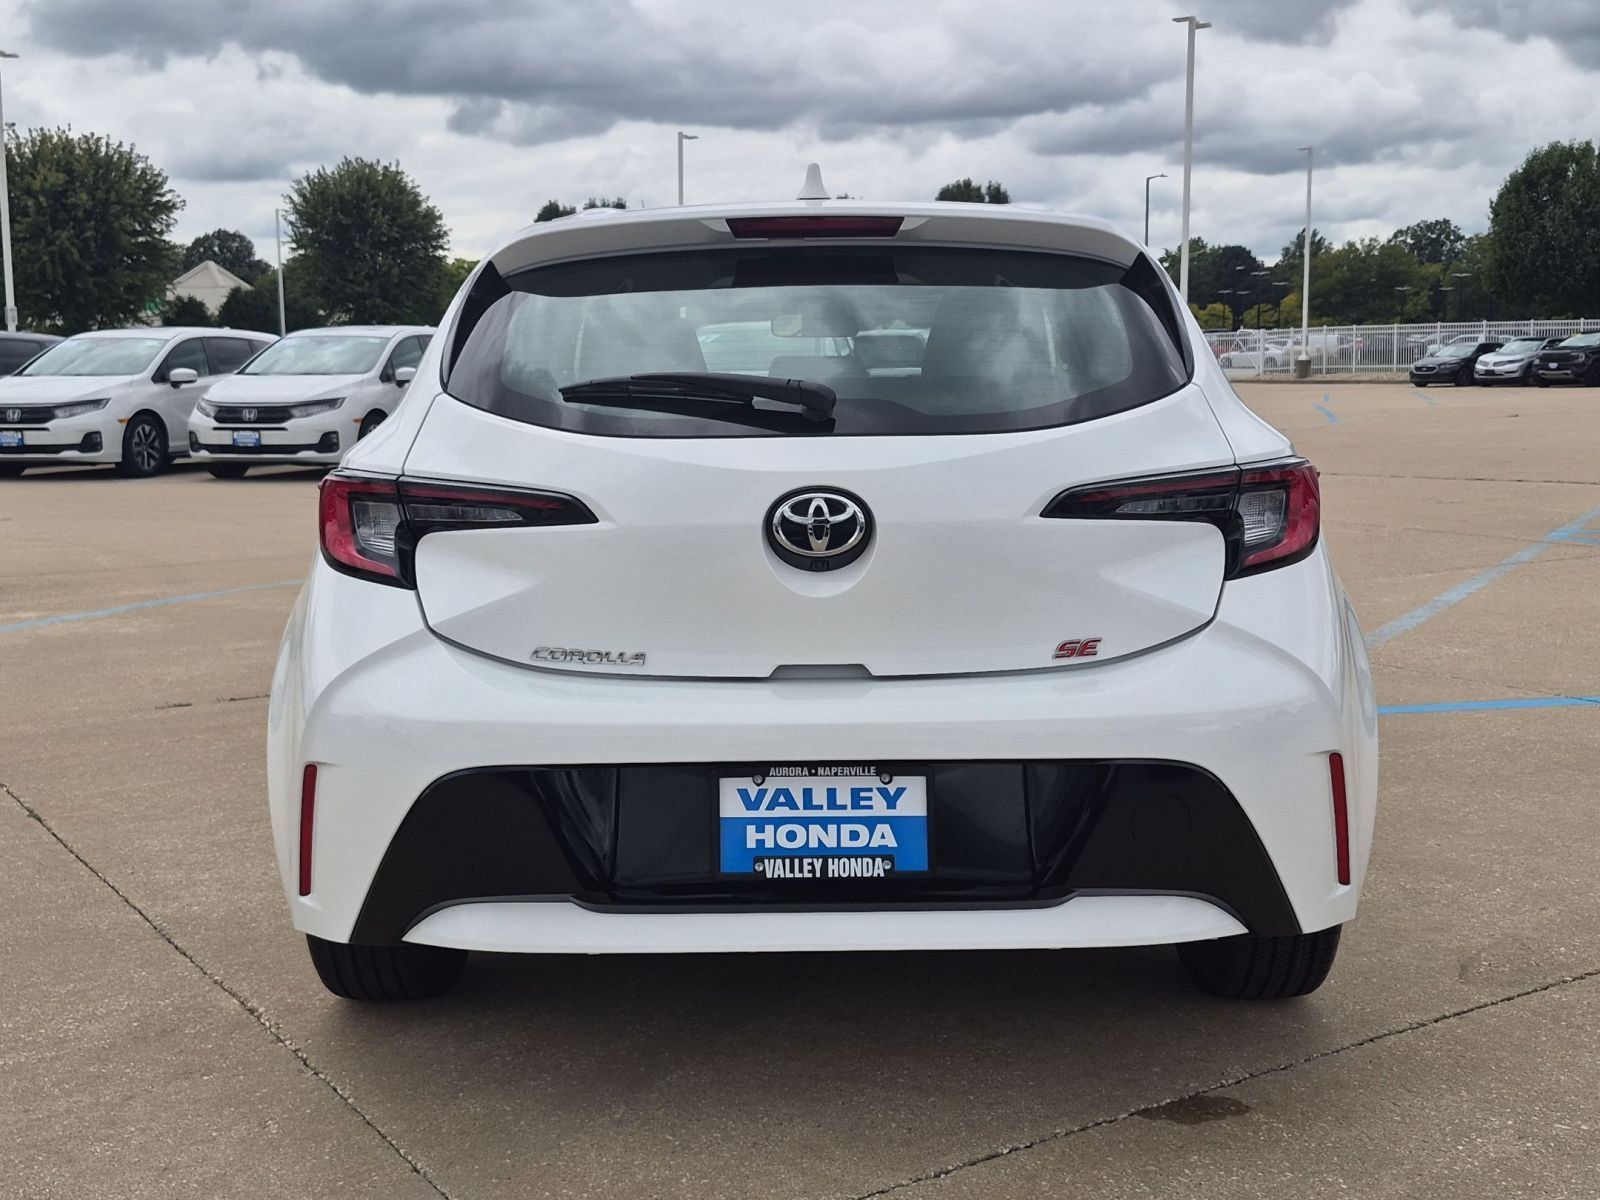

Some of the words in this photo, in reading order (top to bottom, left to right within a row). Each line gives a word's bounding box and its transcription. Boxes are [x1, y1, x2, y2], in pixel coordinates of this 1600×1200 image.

[531, 646, 647, 666] COROLLA
[1052, 636, 1102, 659] SE
[769, 767, 809, 777] AURORA
[817, 766, 877, 776] NAPERVILLE
[736, 787, 907, 812] VALLEY
[746, 823, 898, 849] HONDA
[764, 858, 823, 879] VALLEY
[827, 857, 885, 878] HONDA
